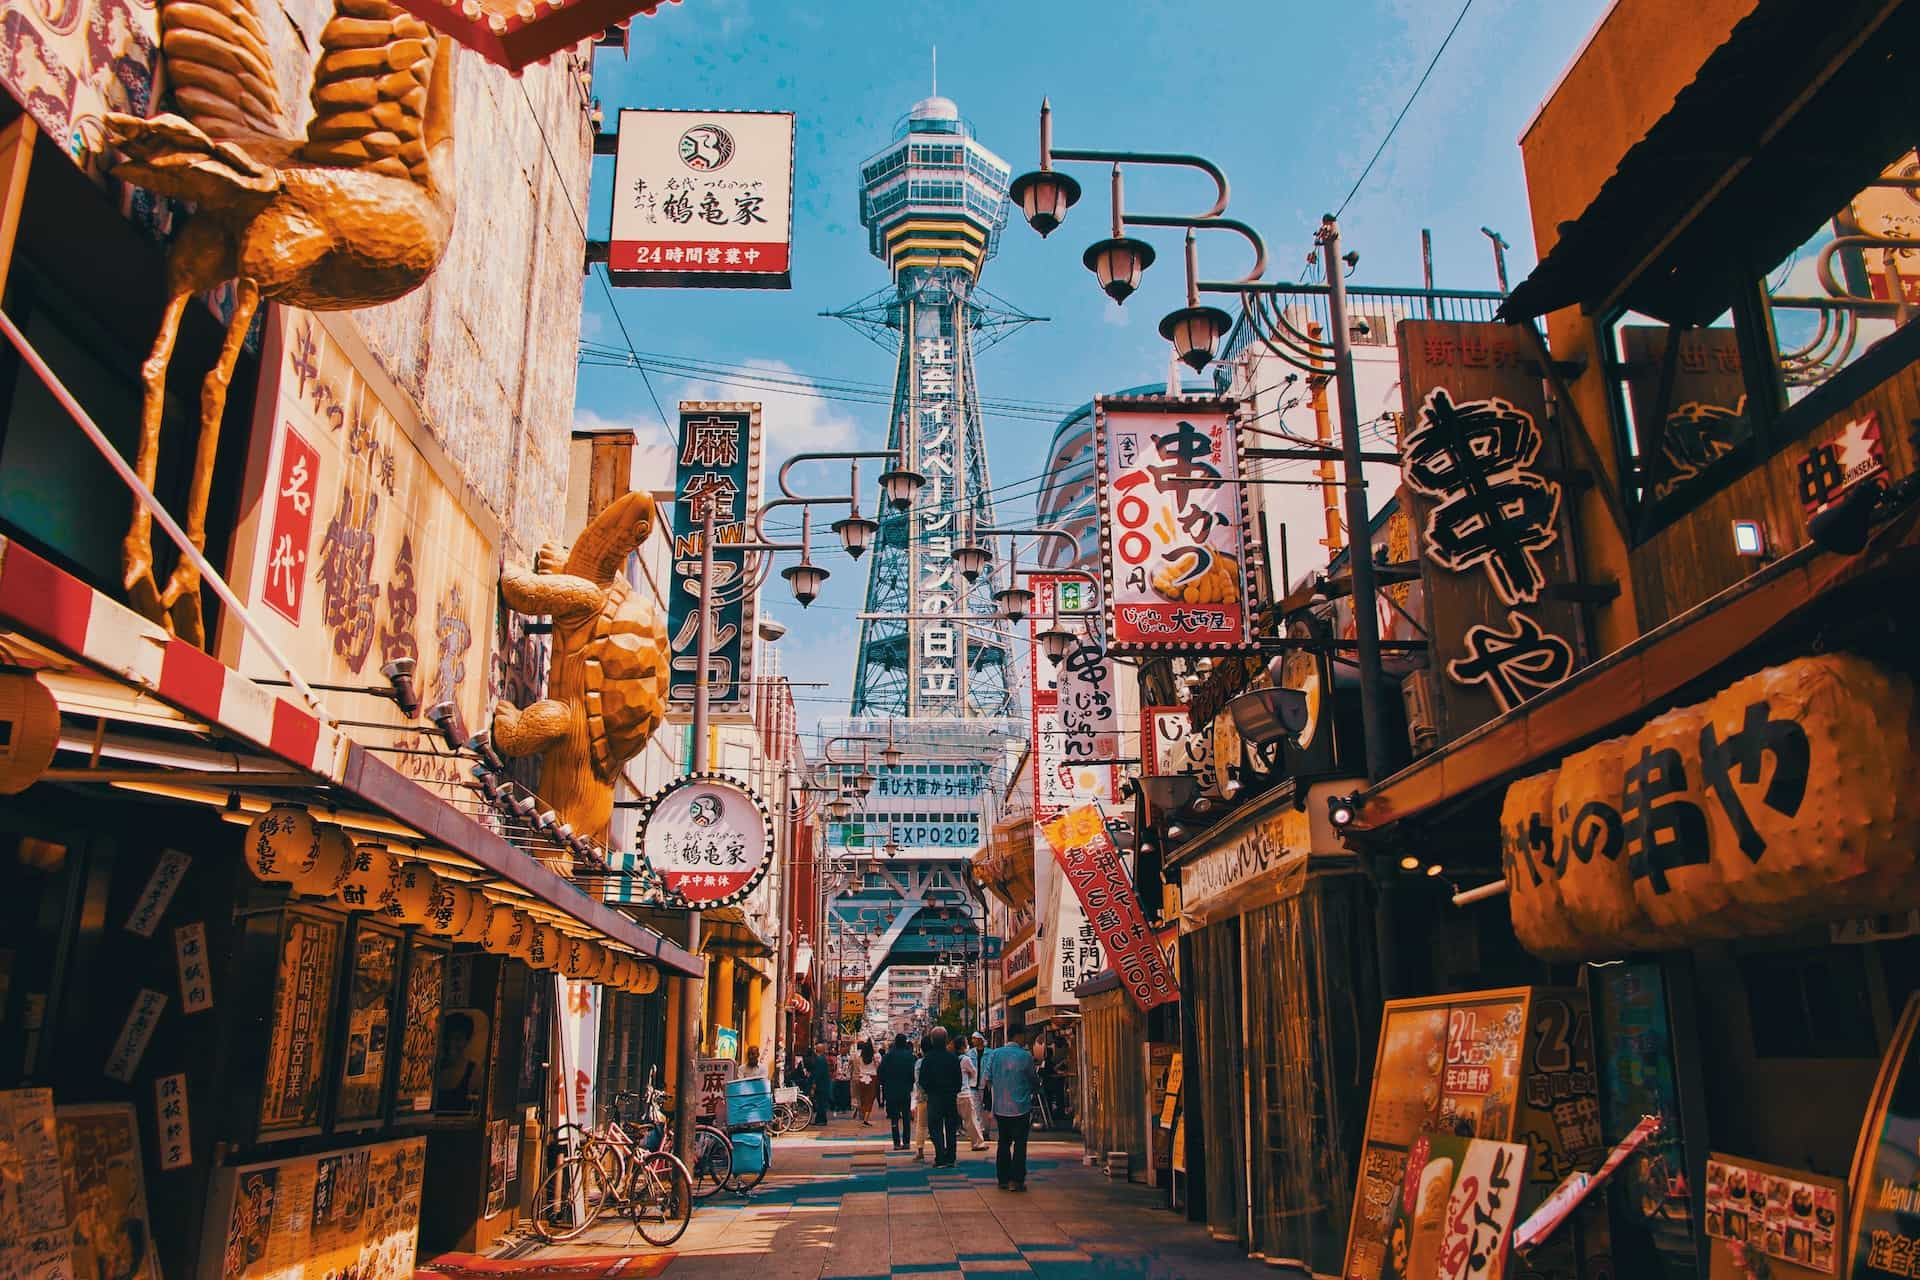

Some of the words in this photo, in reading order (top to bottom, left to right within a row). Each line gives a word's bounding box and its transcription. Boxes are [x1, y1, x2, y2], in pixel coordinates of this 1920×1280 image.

[663, 190, 768, 225] 鶴亀家
[636, 246, 761, 265] 24時間営業中
[1424, 335, 1521, 369] 新世界
[1119, 437, 1134, 466] 全て
[679, 416, 740, 523] 麻雀
[1147, 421, 1231, 586] 串かつ
[270, 456, 313, 609] 名代
[674, 521, 745, 560] NW
[1170, 608, 1232, 632] 大西屋
[682, 839, 748, 866] 鶴亀家
[680, 874, 730, 888] 年中無休
[1444, 1068, 1491, 1092] 年中無休
[1880, 1178, 1910, 1212] Menu
